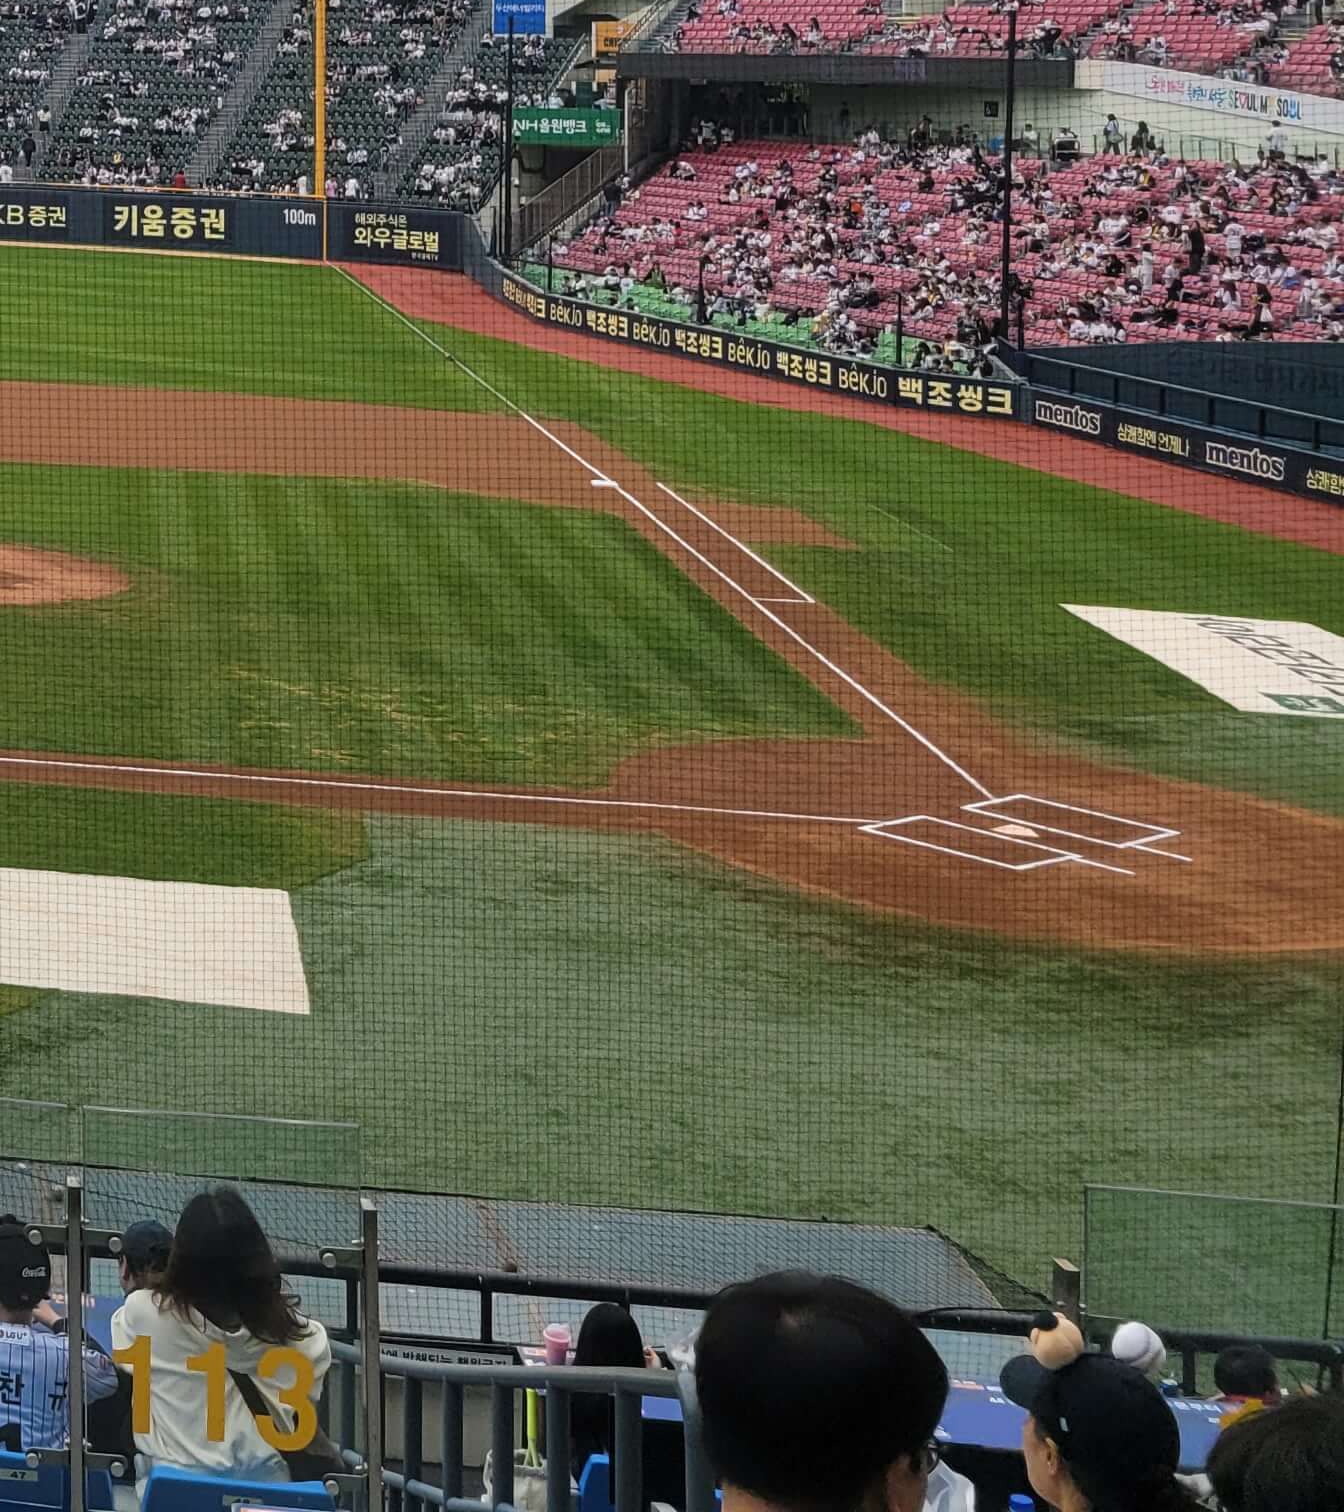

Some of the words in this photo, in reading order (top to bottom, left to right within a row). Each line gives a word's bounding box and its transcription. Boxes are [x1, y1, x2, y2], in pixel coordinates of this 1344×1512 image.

[112, 204, 226, 241] 키움증권
[282, 207, 317, 227] 100m
[353, 226, 440, 253] 와우글로벌
[674, 326, 723, 360] 백조씽크
[776, 349, 832, 387] 백조씽크
[897, 376, 1014, 416] 백조씽크
[1034, 399, 1102, 436] mentos
[1205, 440, 1286, 482] mentos
[113, 1334, 317, 1453] 113
[7, 1469, 28, 1481] 47
